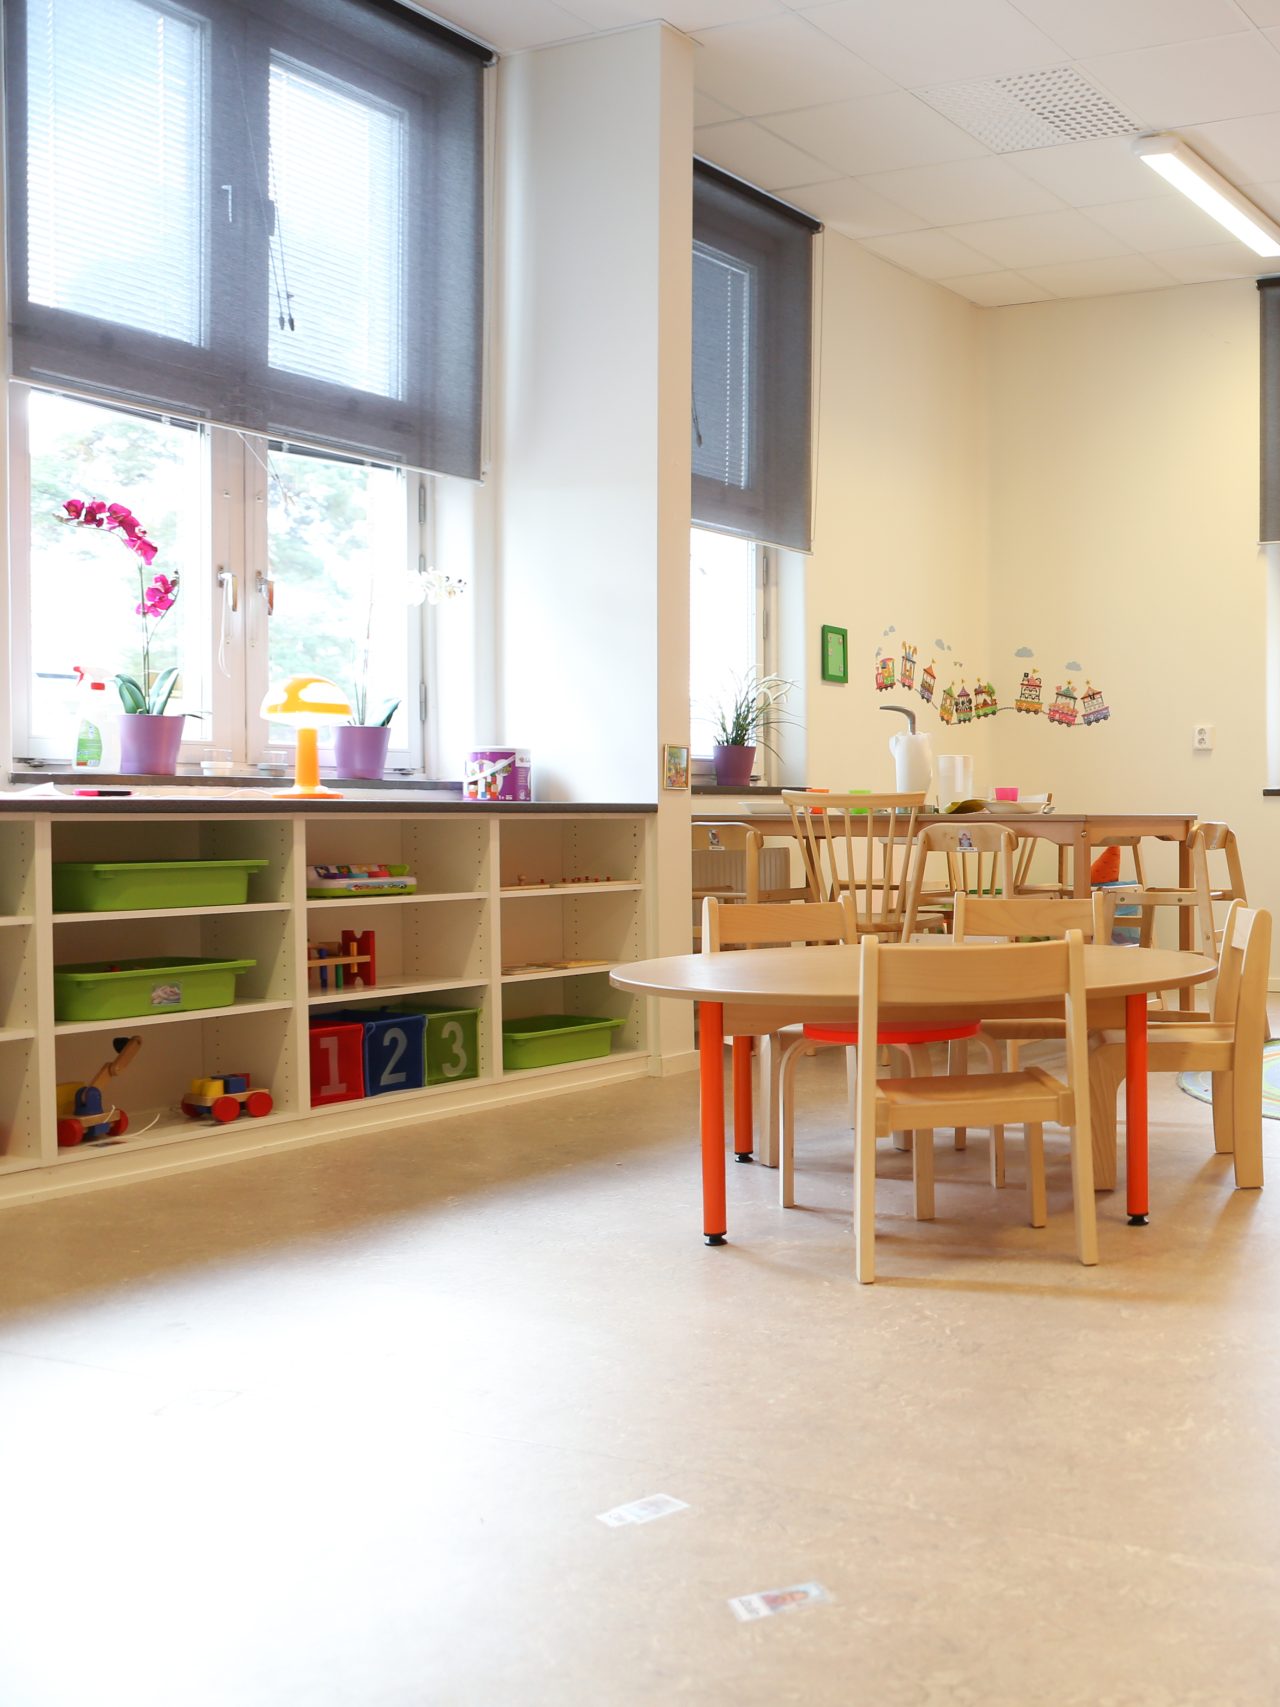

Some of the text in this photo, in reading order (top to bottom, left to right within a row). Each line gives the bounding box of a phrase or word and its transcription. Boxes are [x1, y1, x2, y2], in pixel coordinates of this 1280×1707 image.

[320, 1036, 347, 1096] 1
[380, 1028, 408, 1086] 2
[442, 1021, 467, 1077] 3
